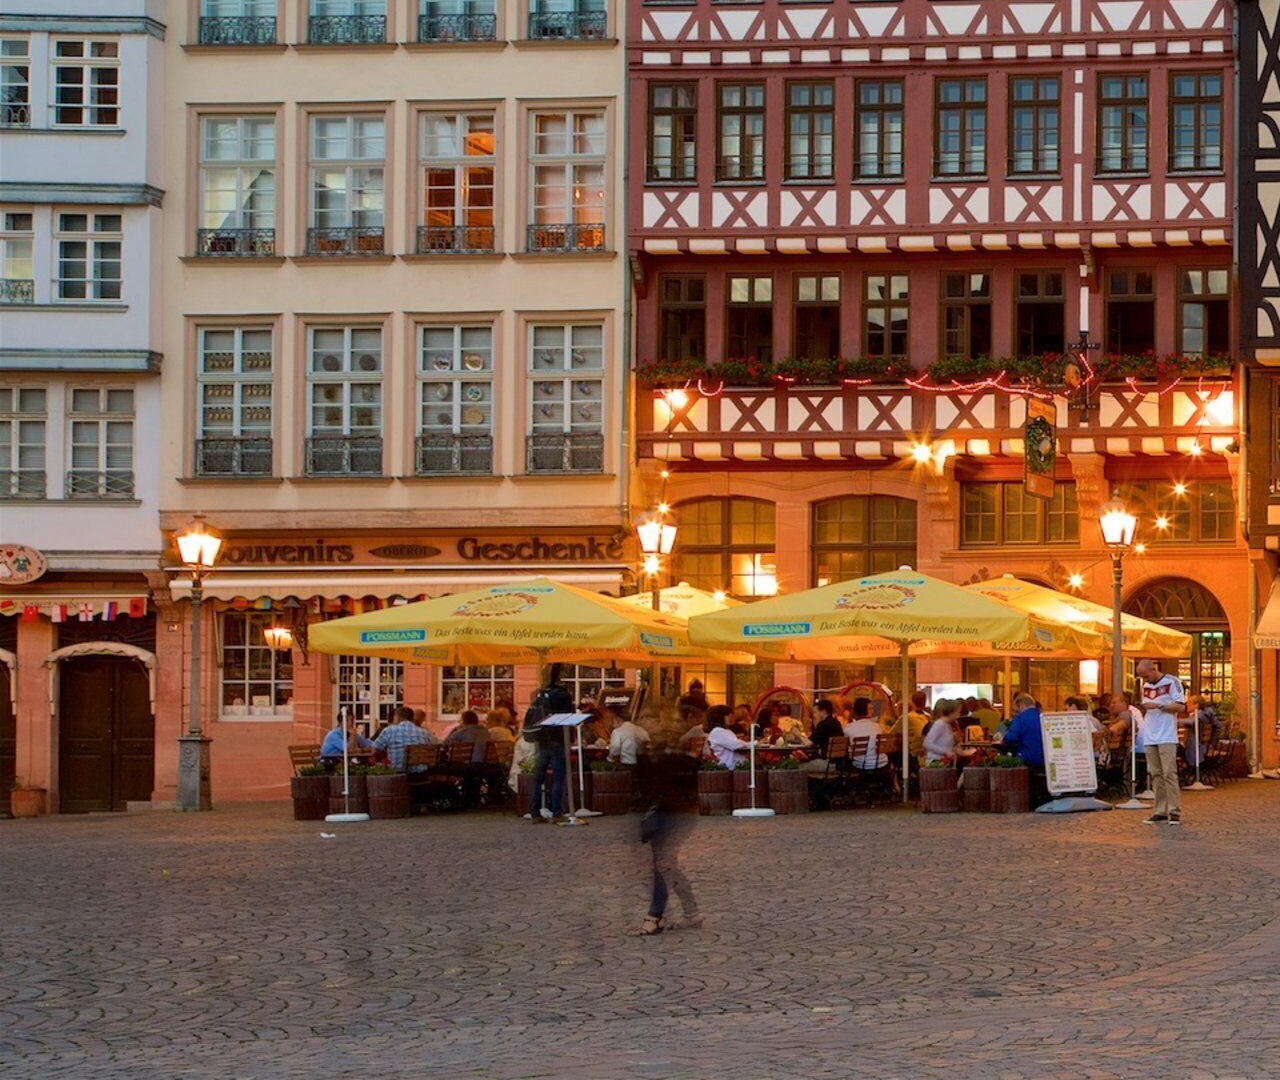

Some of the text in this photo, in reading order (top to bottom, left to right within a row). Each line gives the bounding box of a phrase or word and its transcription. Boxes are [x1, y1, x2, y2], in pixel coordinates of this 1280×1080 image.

[457, 536, 624, 560] Geschenke
[748, 625, 806, 634] POSSMANN
[819, 621, 837, 631] Das
[879, 622, 896, 630] ein
[897, 622, 920, 633] Apfel
[366, 631, 422, 641] POSSMANN
[434, 628, 451, 637] Das
[511, 629, 532, 639] Apfel
